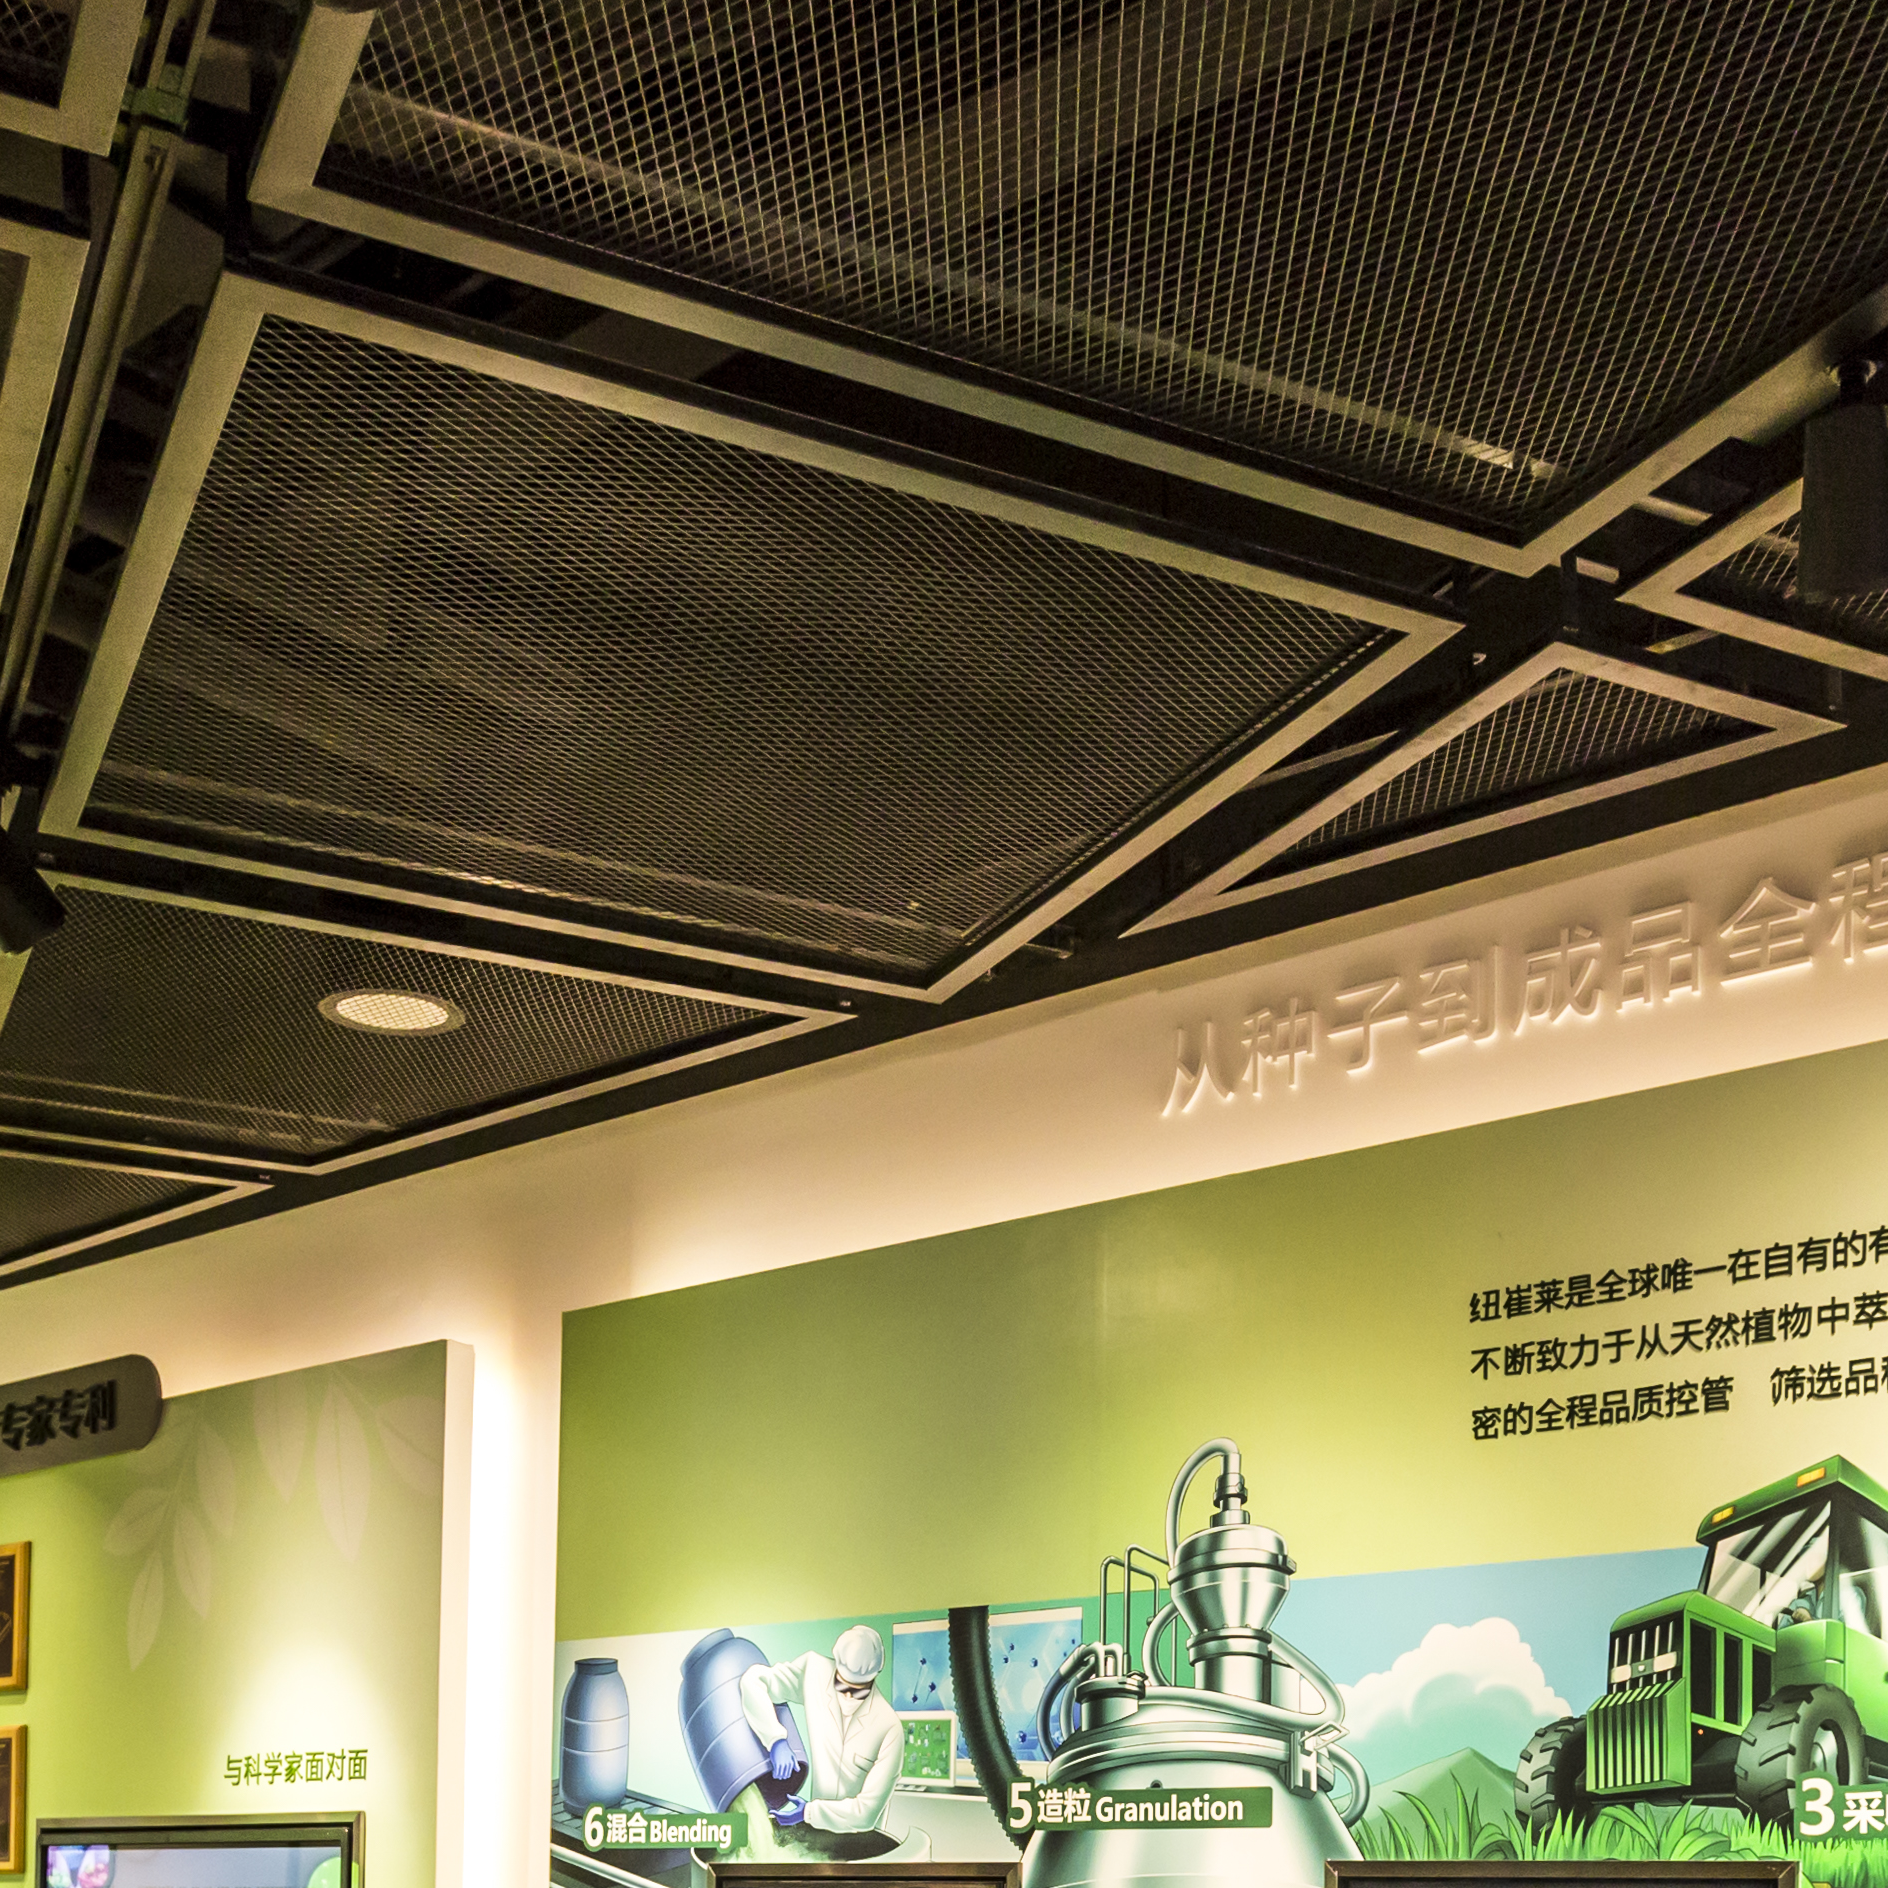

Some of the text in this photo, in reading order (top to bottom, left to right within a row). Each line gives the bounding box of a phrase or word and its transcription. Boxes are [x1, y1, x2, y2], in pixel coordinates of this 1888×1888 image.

[224, 1749, 368, 1786] 与科学家面对面
[1037, 1787, 1091, 1823] 造粒
[1095, 1794, 1243, 1822] Granulation
[606, 1812, 648, 1844] 混合
[650, 1818, 732, 1849] Blending
